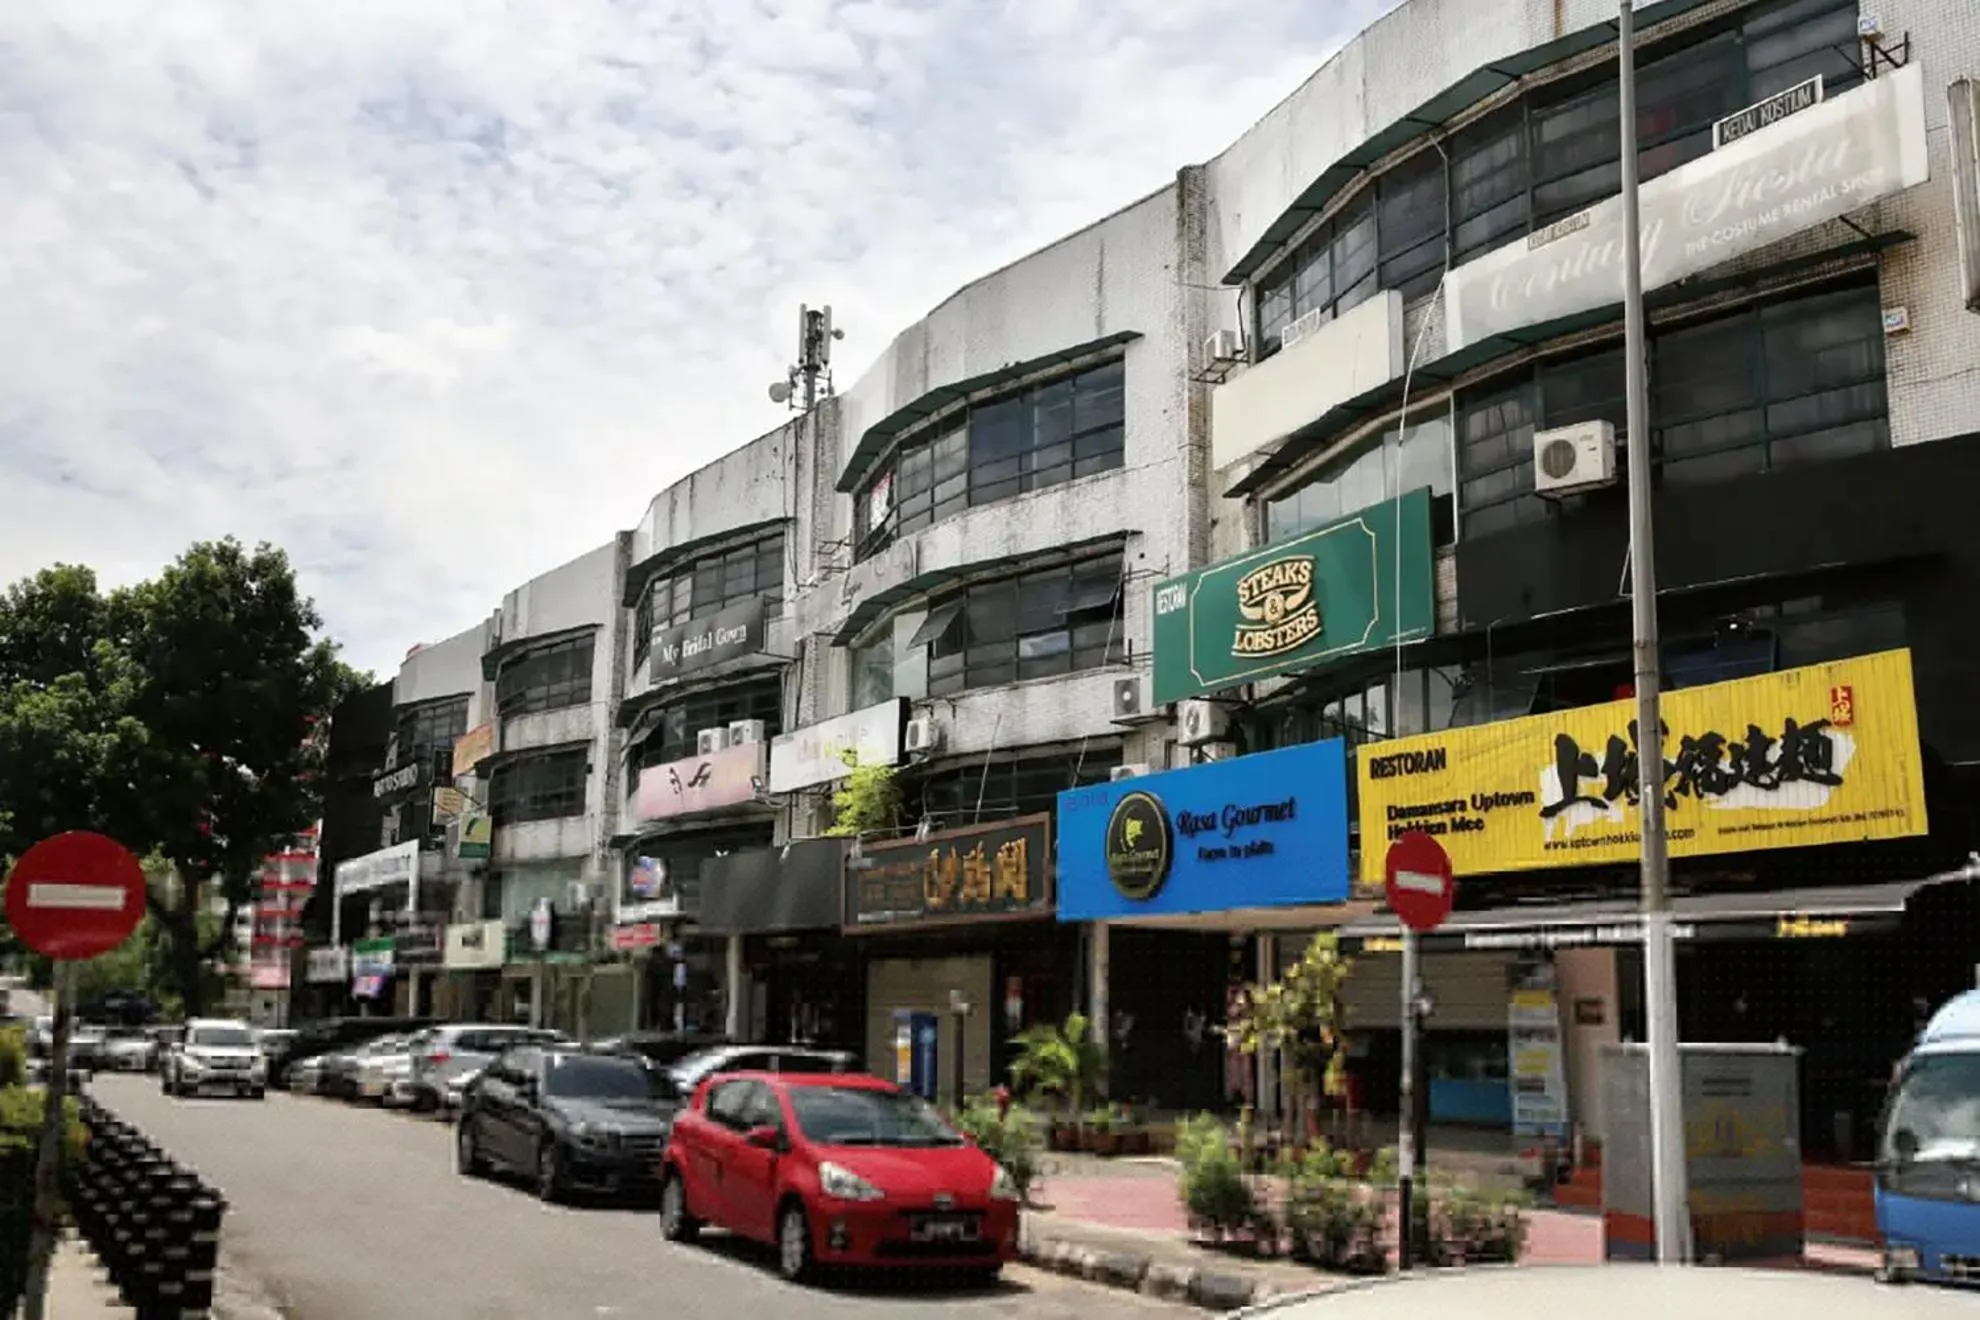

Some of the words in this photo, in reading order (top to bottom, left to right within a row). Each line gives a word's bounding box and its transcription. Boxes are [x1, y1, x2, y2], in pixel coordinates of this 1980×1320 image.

[1685, 237, 1709, 258] THE
[1711, 207, 1781, 246] COSTUME
[1238, 559, 1313, 602] STEAKS
[1268, 597, 1281, 614] &
[663, 643, 681, 667] My
[716, 623, 748, 646] Gown
[1232, 607, 1319, 651] LOBSTERS
[1369, 746, 1447, 780] RESTORAN
[1219, 796, 1297, 838] Gourmet
[1386, 797, 1468, 822] Damansara
[1470, 790, 1536, 813] Uptown
[1450, 815, 1486, 834] Mee
